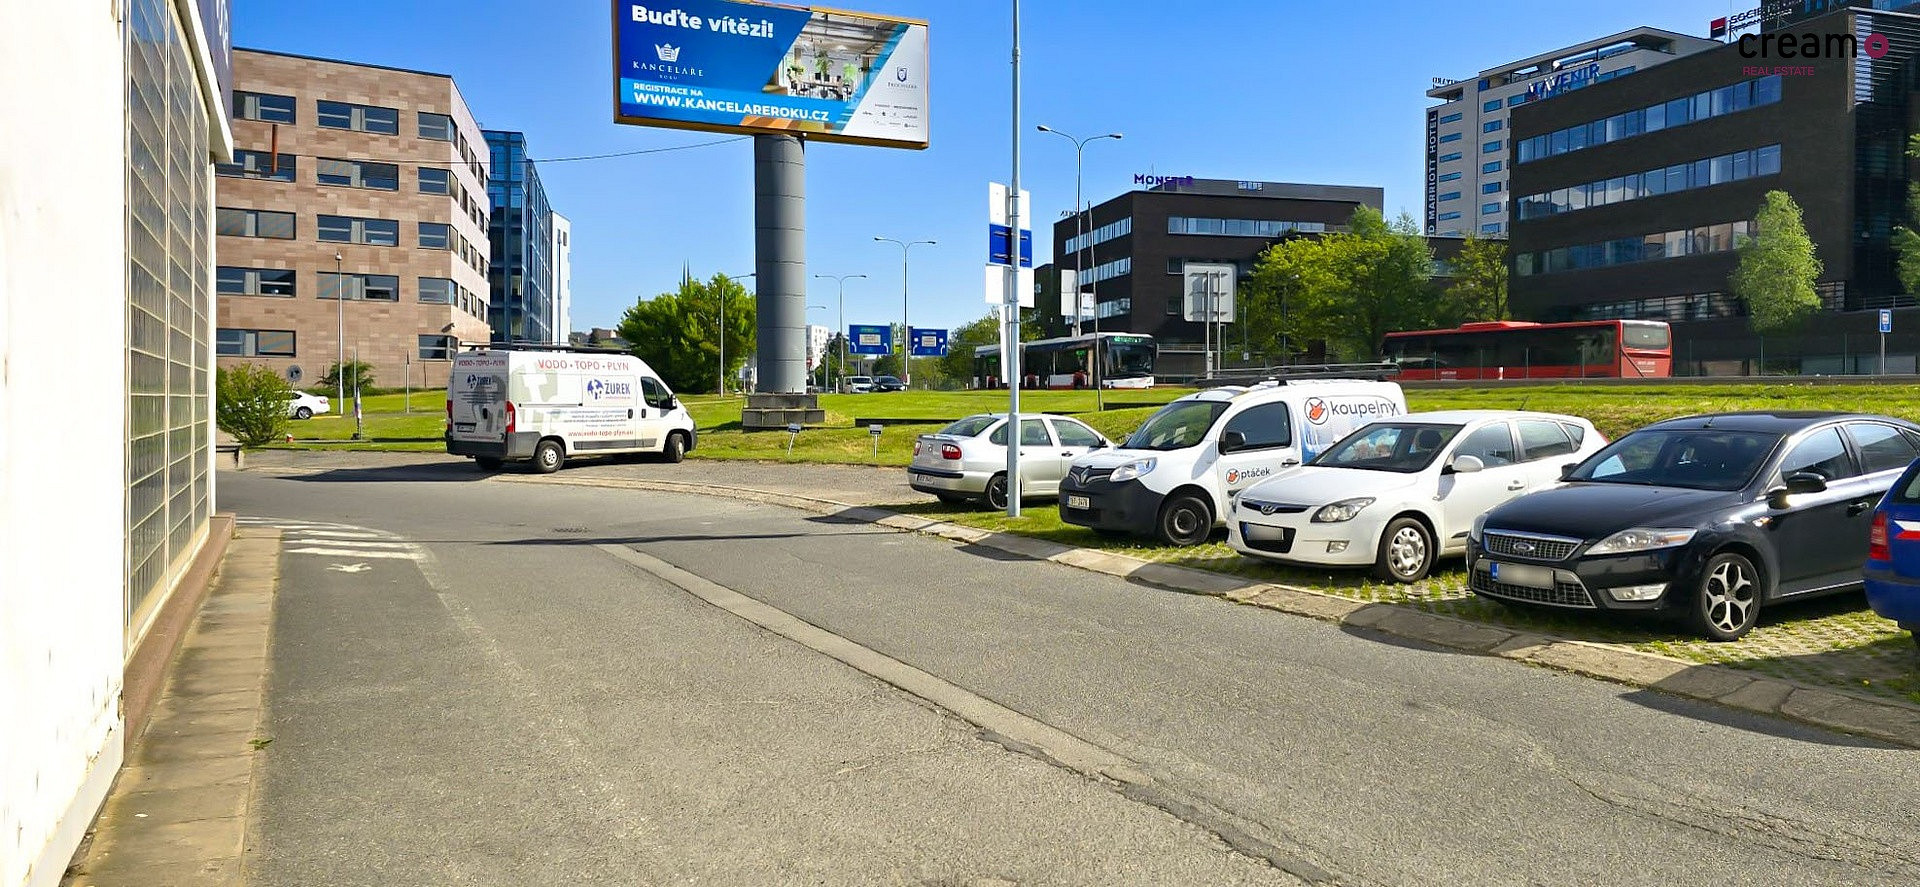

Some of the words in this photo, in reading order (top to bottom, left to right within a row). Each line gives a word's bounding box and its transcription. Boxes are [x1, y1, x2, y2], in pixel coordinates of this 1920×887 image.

[631, 4, 703, 30] Buďte
[708, 15, 774, 39] vítězi!
[633, 82, 689, 96] REGISTRACE
[690, 88, 704, 97] NA
[633, 91, 830, 122] WWW.KANCELAREROKU.CZ
[1428, 114, 1438, 154] HOTEL
[1428, 160, 1437, 220] MARRIOTT
[538, 359, 568, 370] VODO
[575, 360, 600, 371] TOPO
[607, 361, 629, 371] PLYN
[1331, 400, 1397, 418] koupelny
[1241, 466, 1271, 480] ptáček
